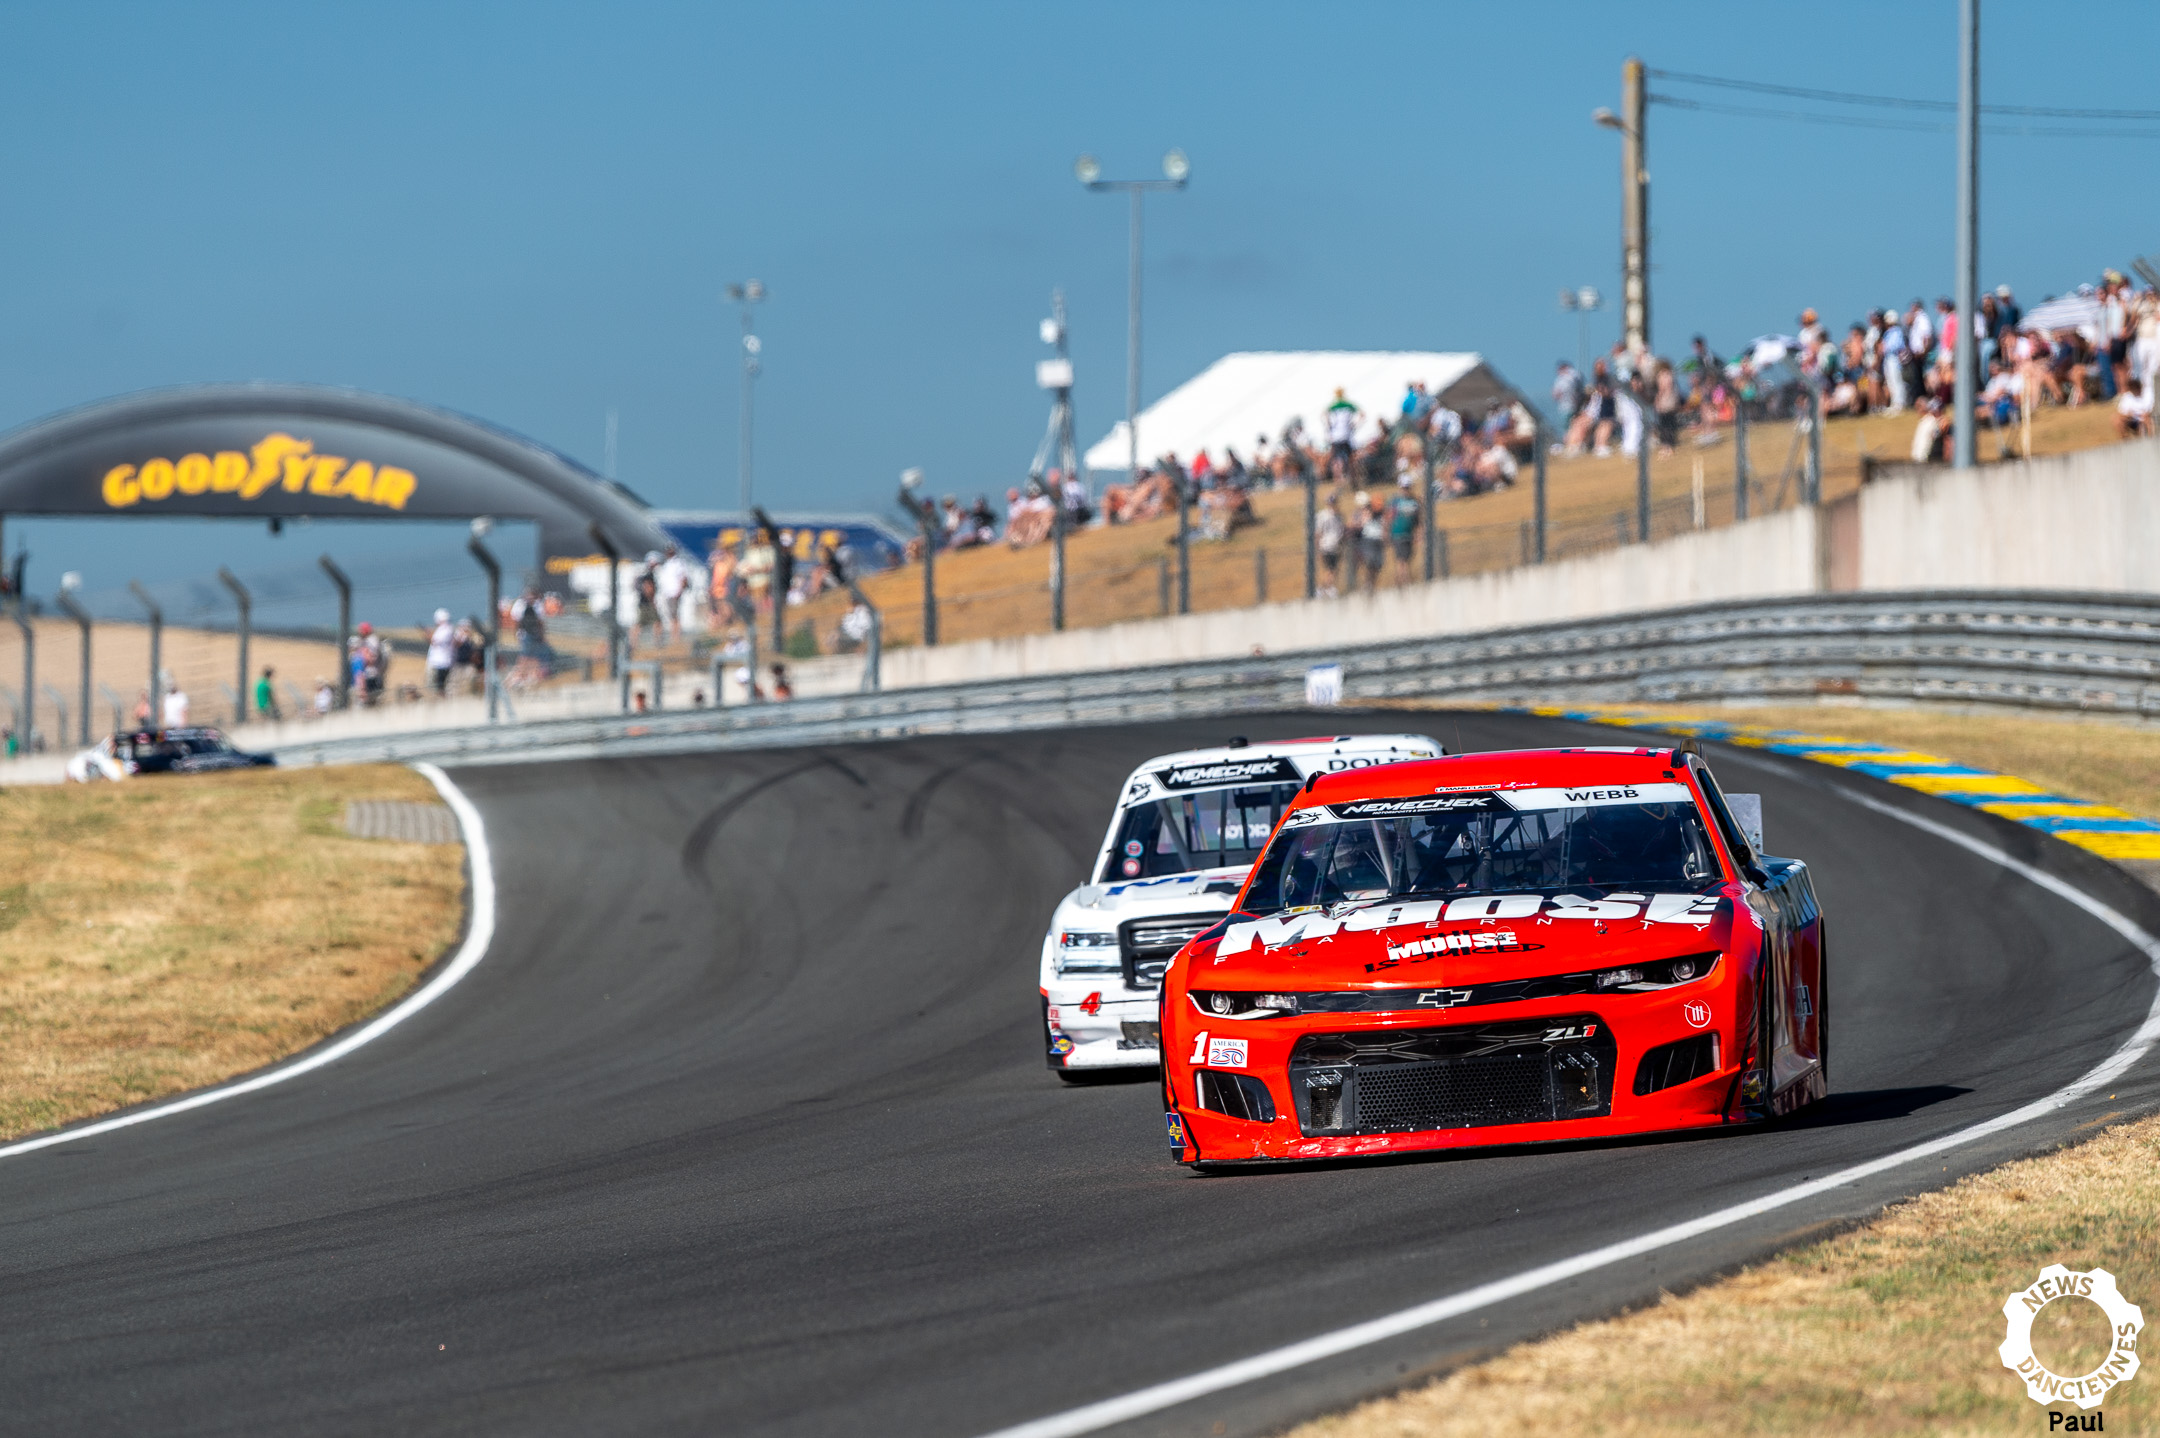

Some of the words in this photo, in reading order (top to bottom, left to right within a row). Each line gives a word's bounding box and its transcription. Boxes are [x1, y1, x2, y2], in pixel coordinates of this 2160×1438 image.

[102, 432, 418, 511] GOODYEAR
[1168, 761, 1280, 784] NEMECHEK
[1342, 797, 1493, 815] NEMECHEK
[1565, 789, 1640, 802] WEBB
[1215, 893, 1720, 957] MOOSE
[1387, 931, 1518, 960] MOOSE
[1364, 959, 1400, 974] IS
[1410, 943, 1546, 964] JUICED
[1080, 991, 1102, 1016] 4
[1212, 1040, 1245, 1048] AMERICA
[1542, 1024, 1597, 1041] ZL1
[1188, 1030, 1210, 1065] 1
[1210, 1048, 1245, 1066] 250
